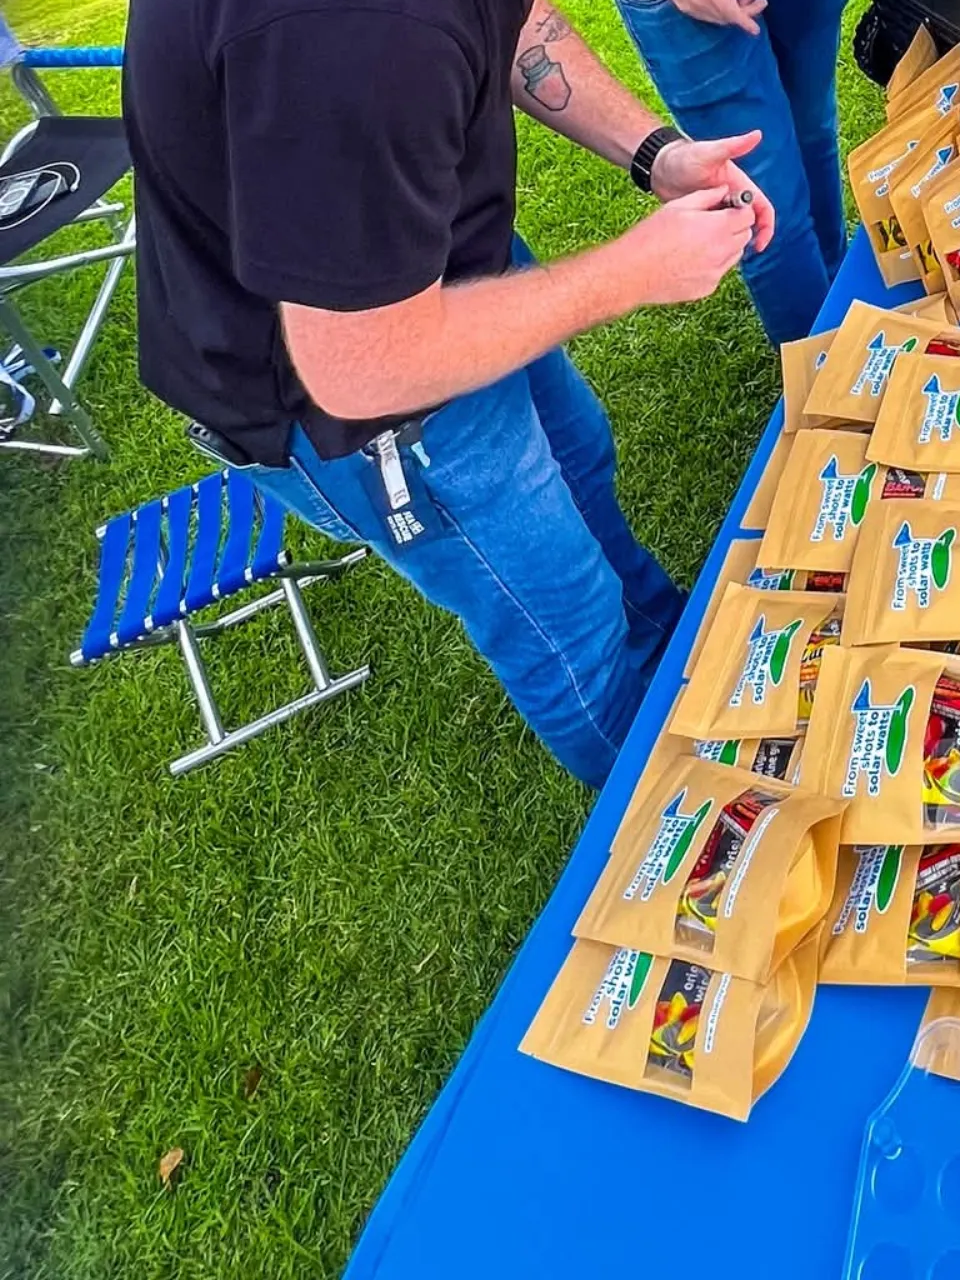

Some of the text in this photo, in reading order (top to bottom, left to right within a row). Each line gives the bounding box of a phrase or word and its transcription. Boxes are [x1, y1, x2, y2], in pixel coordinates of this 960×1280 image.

[835, 479, 845, 491] to
[834, 511, 847, 539] solar
[906, 541, 921, 587] shots to
[918, 541, 932, 607] solar watts
[893, 578, 906, 609] From
[844, 711, 868, 795] From sweet
[861, 710, 880, 769] shots to
[869, 710, 890, 794] solar watts
[855, 890, 872, 931] solar
